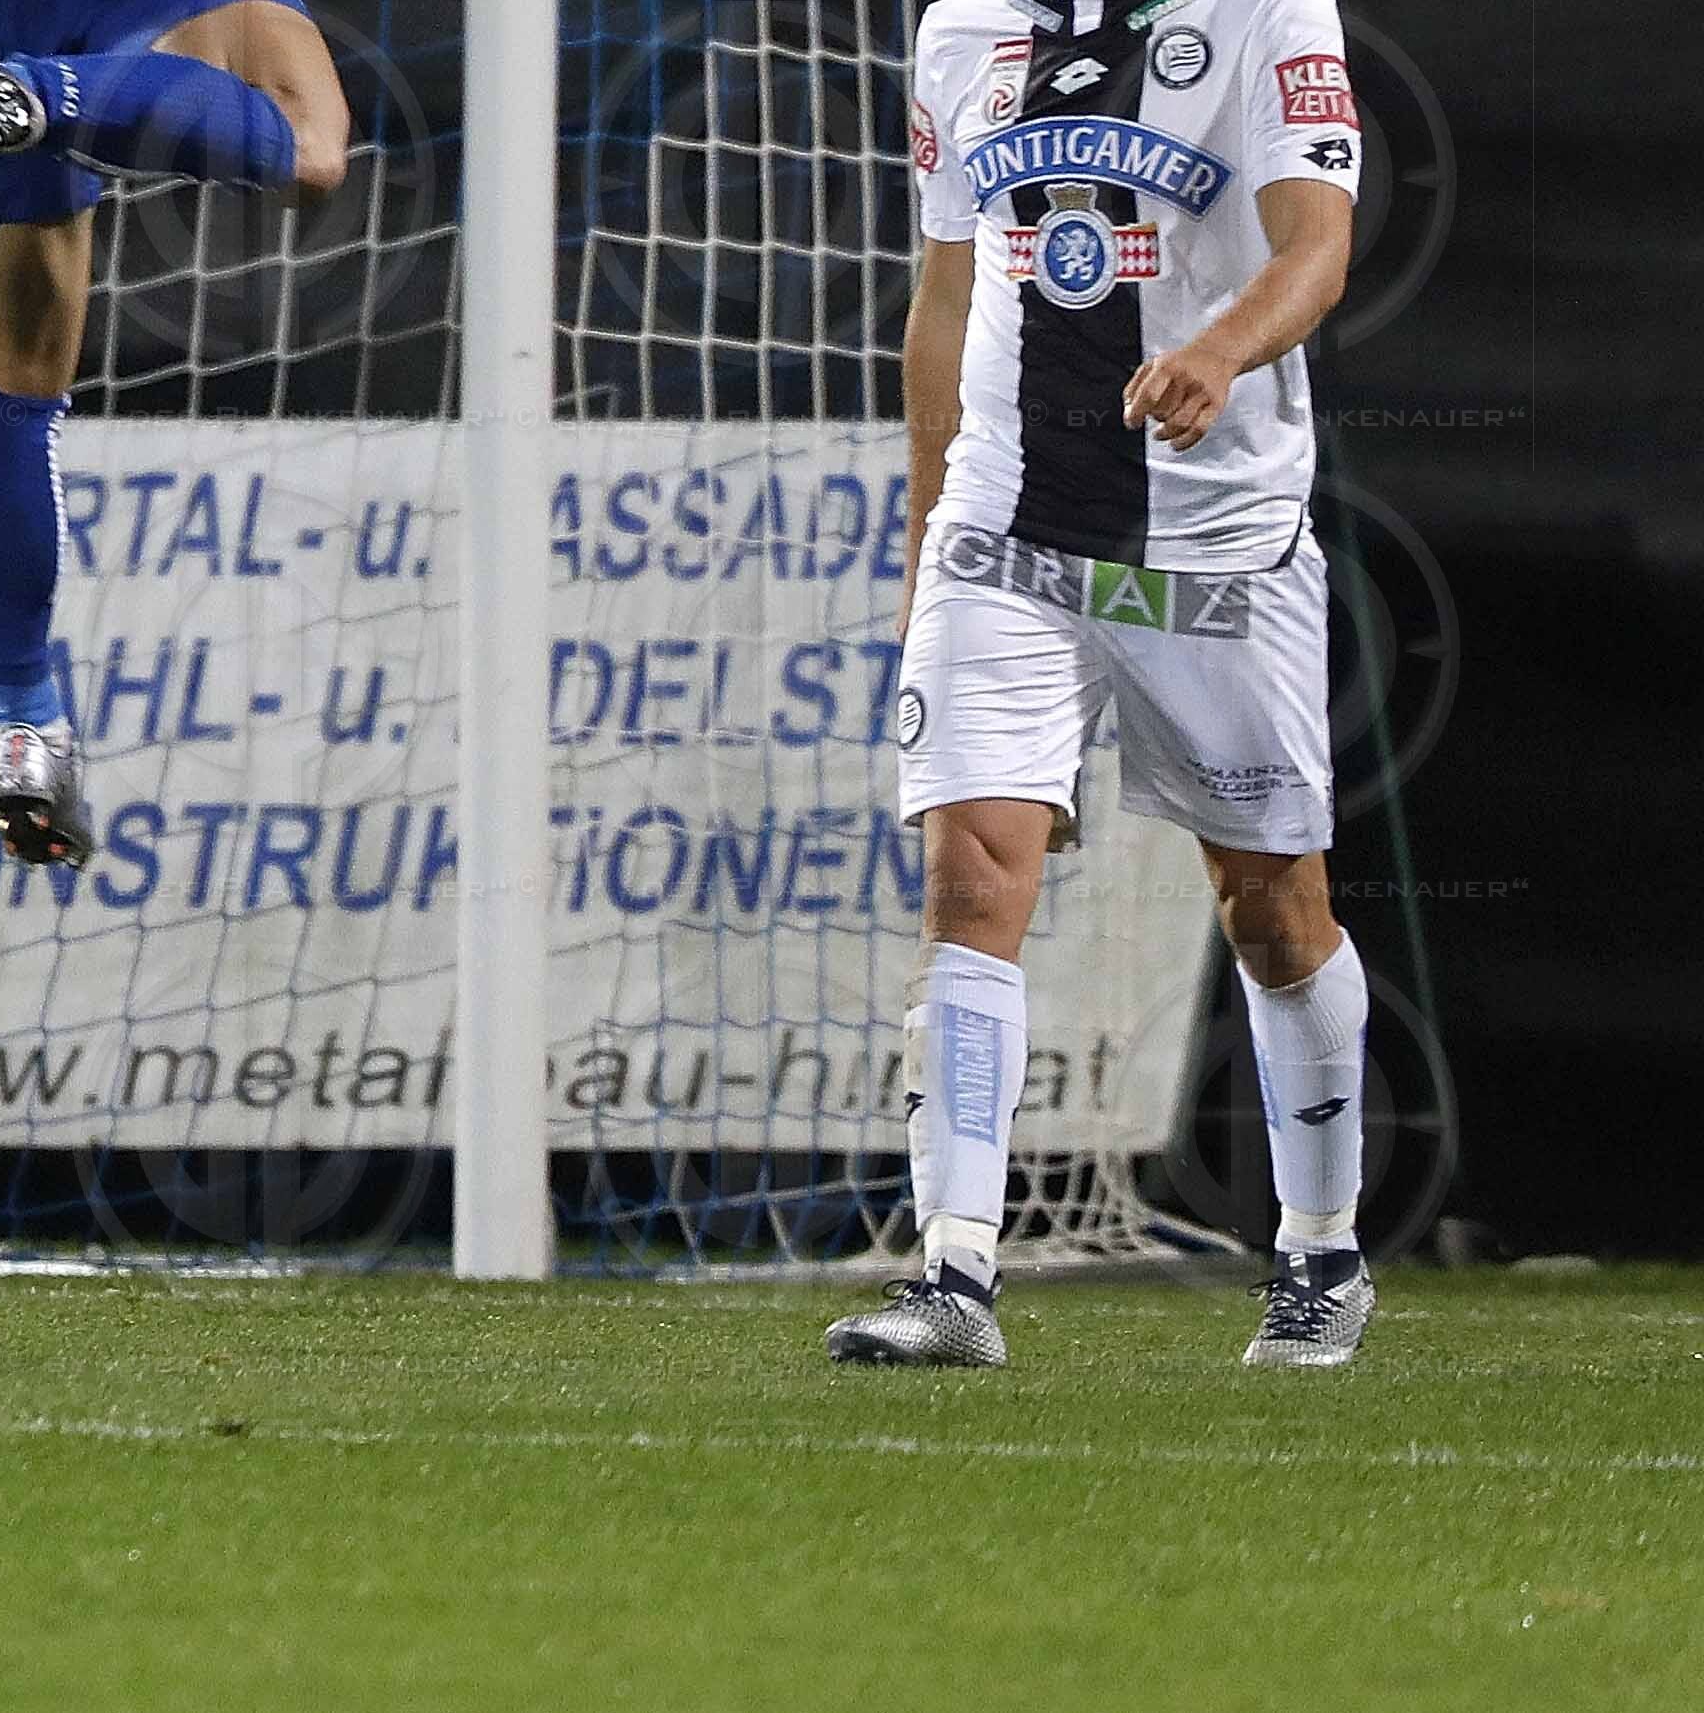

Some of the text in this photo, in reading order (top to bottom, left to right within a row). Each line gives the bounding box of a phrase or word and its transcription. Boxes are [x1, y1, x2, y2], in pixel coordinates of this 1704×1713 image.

[1282, 61, 1350, 93] KLE
[1287, 90, 1358, 119] ZEIT
[357, 499, 431, 578] u.
[550, 470, 909, 581] ASSADE
[945, 529, 1245, 633] GRAZ
[319, 666, 408, 744] u.
[955, 1009, 995, 1136] PUNTIGAME
